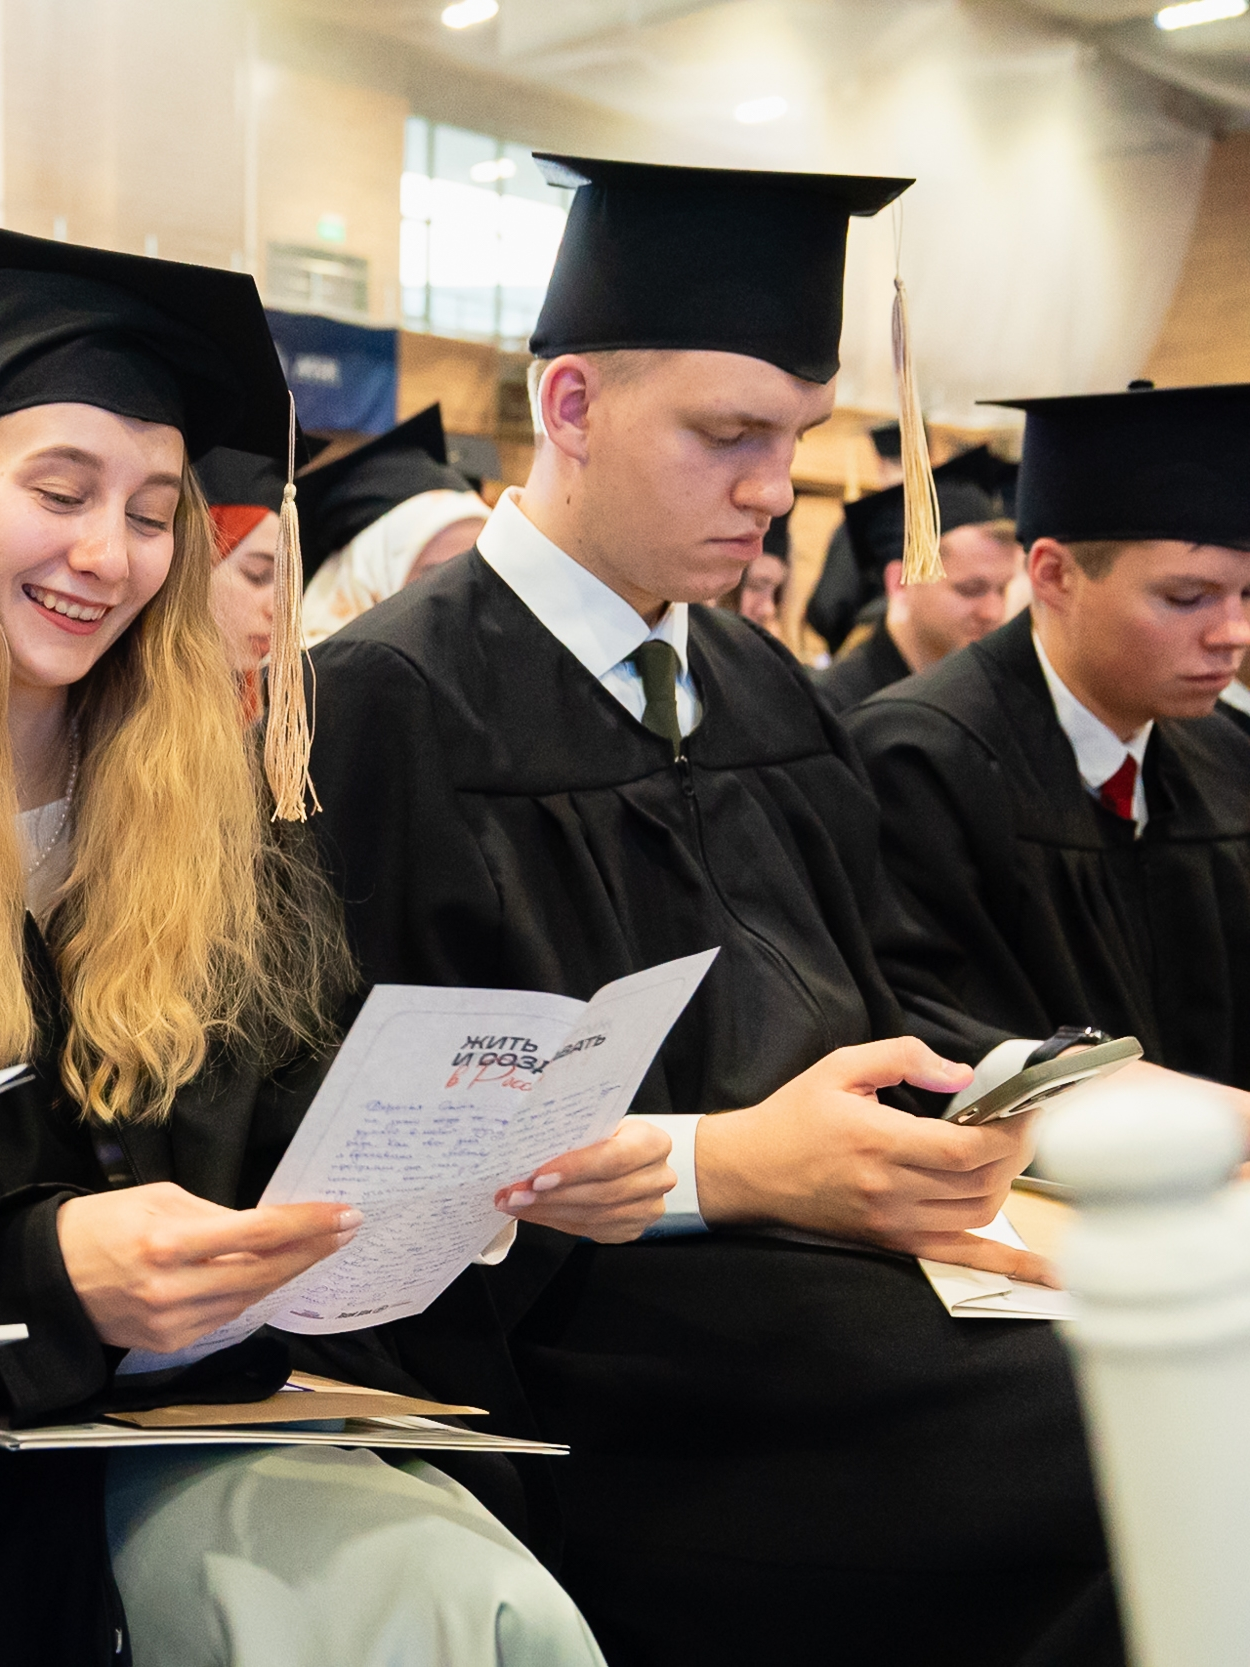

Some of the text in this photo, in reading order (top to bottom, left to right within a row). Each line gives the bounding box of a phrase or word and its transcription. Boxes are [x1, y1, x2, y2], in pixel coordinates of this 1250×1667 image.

[460, 1035, 538, 1053] ЖИТЬ
[452, 1053, 473, 1067] И
[467, 1056, 544, 1091] Росс
